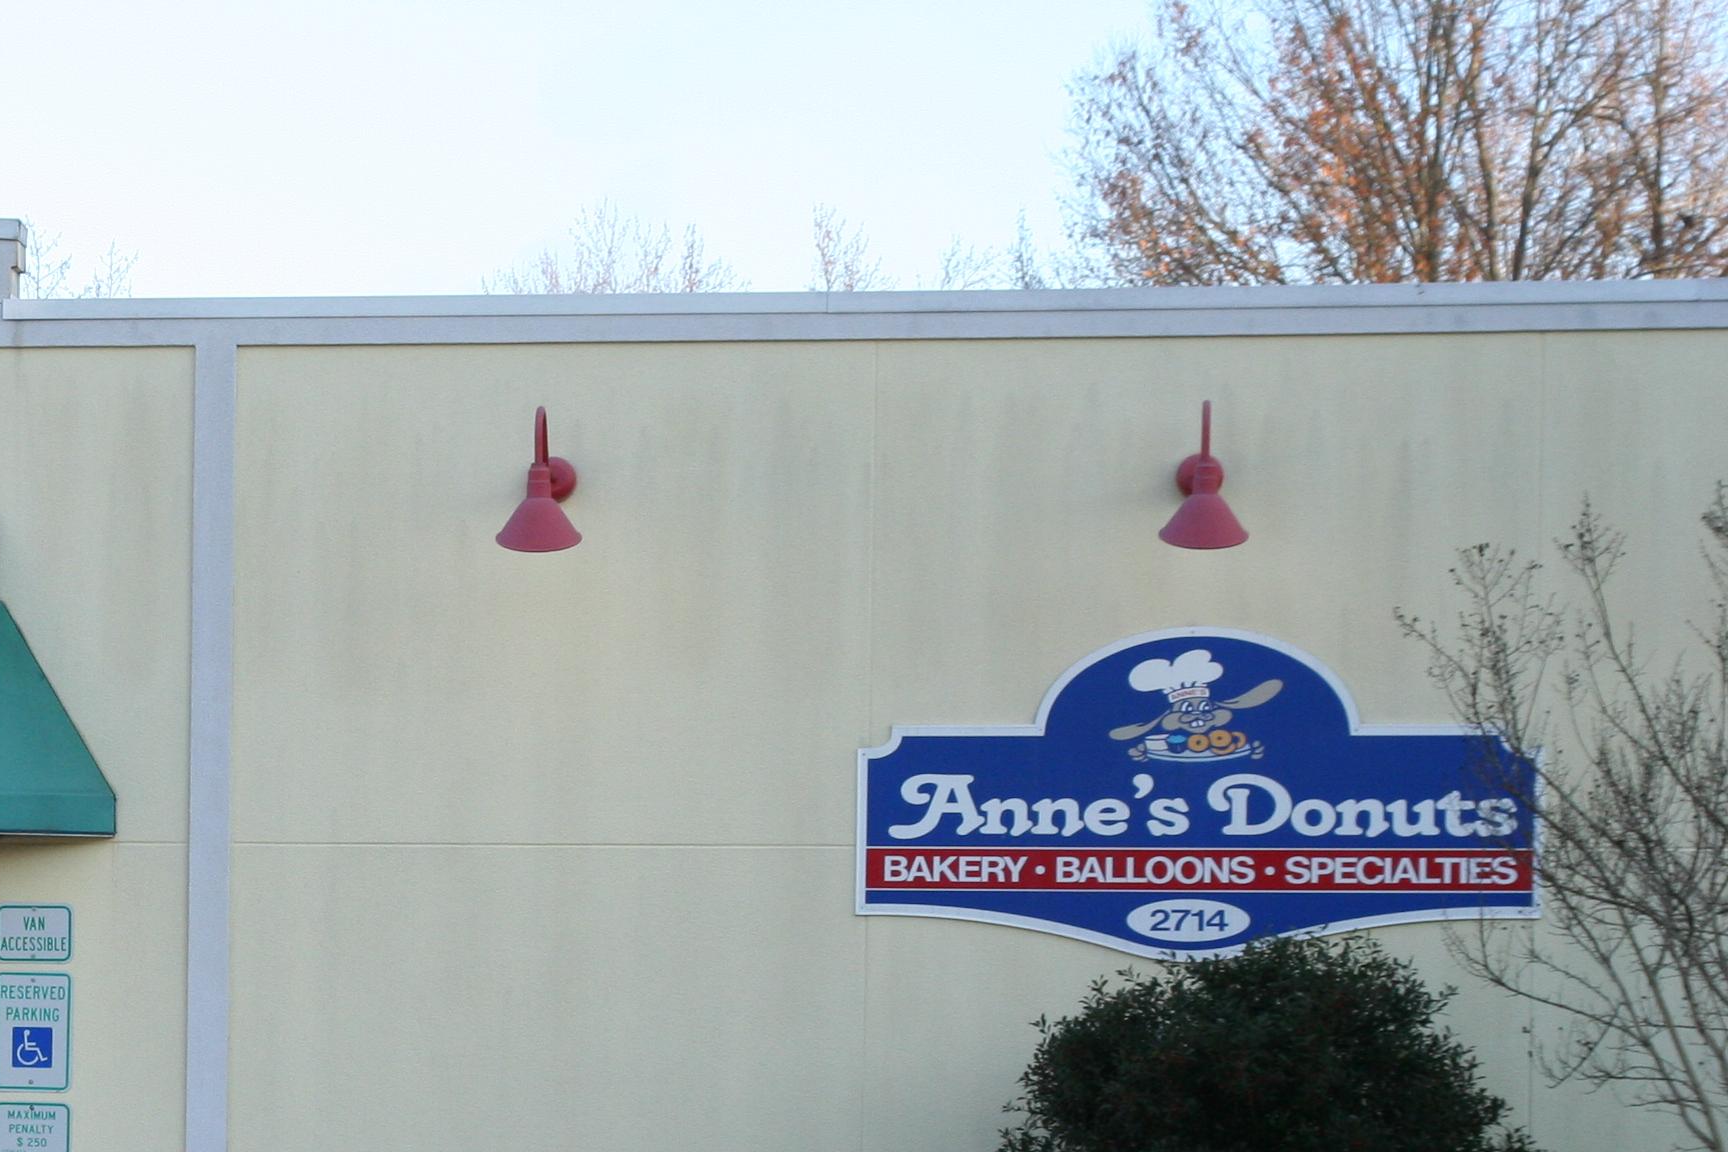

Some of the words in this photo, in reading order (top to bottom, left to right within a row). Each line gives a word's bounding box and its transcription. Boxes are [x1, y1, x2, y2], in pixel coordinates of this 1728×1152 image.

[888, 773, 1190, 840] Anne's
[1206, 773, 1518, 838] Donuts
[883, 855, 1028, 884] BAKERY
[1055, 855, 1255, 885] BALLOONS
[1284, 856, 1519, 886] SPECIALTIES
[22, 915, 46, 931] VAN
[1149, 908, 1229, 932] 2714
[0, 936, 67, 952] ACCESSIBLE
[0, 985, 66, 1000] RESERVED
[5, 1006, 60, 1023] PARKING
[7, 1110, 56, 1121] MAXIMUM
[8, 1123, 55, 1135] PENALTY
[27, 1137, 48, 1148] 250
